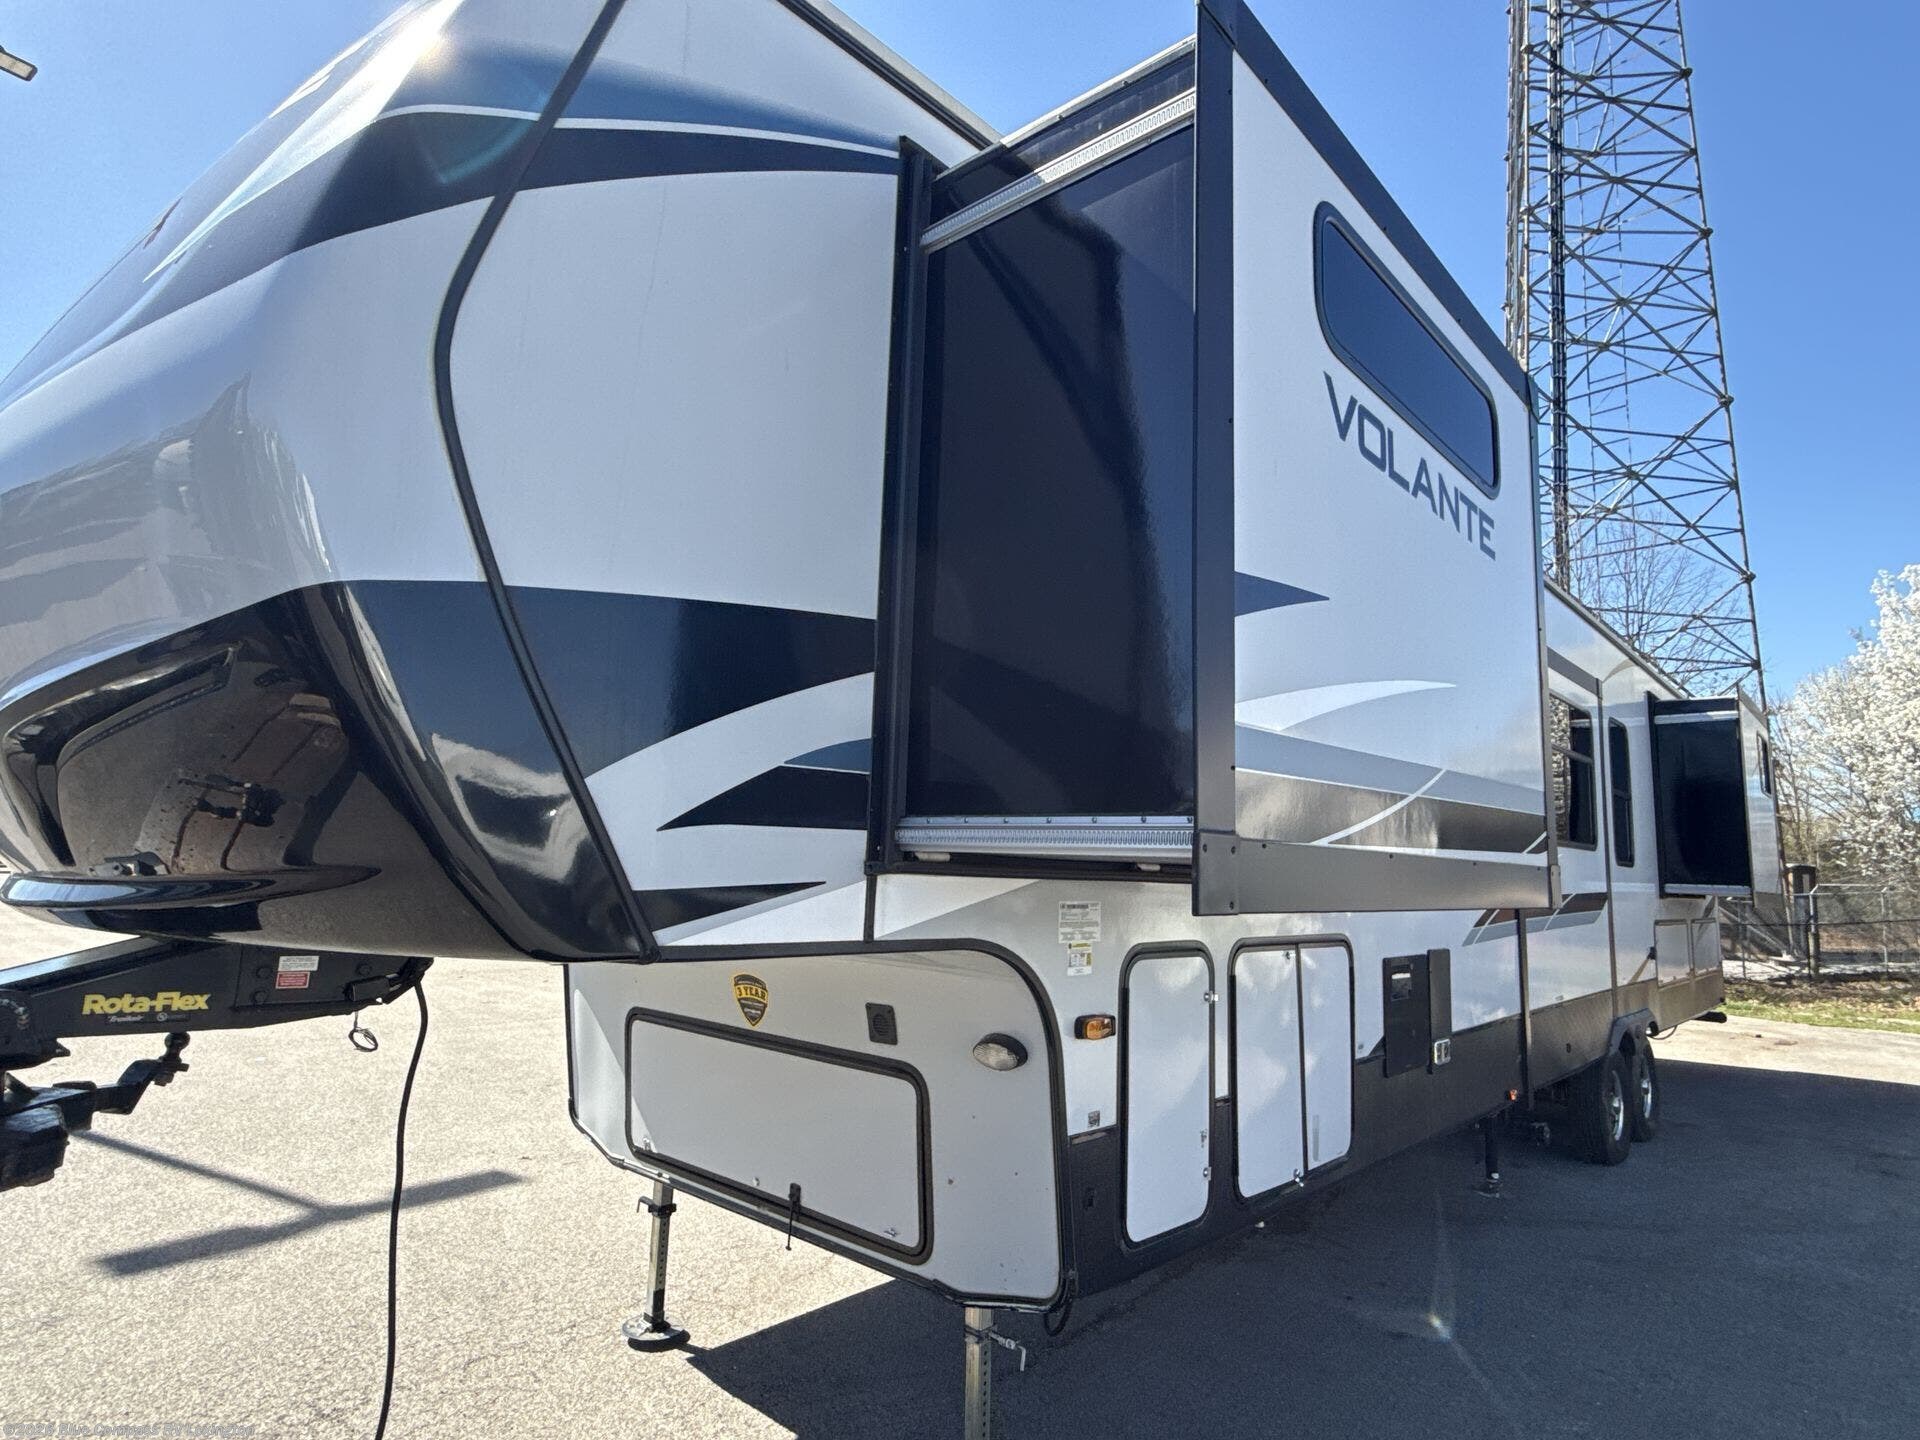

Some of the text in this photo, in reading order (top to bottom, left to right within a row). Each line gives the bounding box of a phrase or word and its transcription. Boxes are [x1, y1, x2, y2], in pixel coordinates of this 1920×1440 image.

[1323, 371, 1496, 561] VOLANTE
[82, 991, 211, 1015] Rota-Flex
[736, 985, 766, 1001] 3 YEAR
